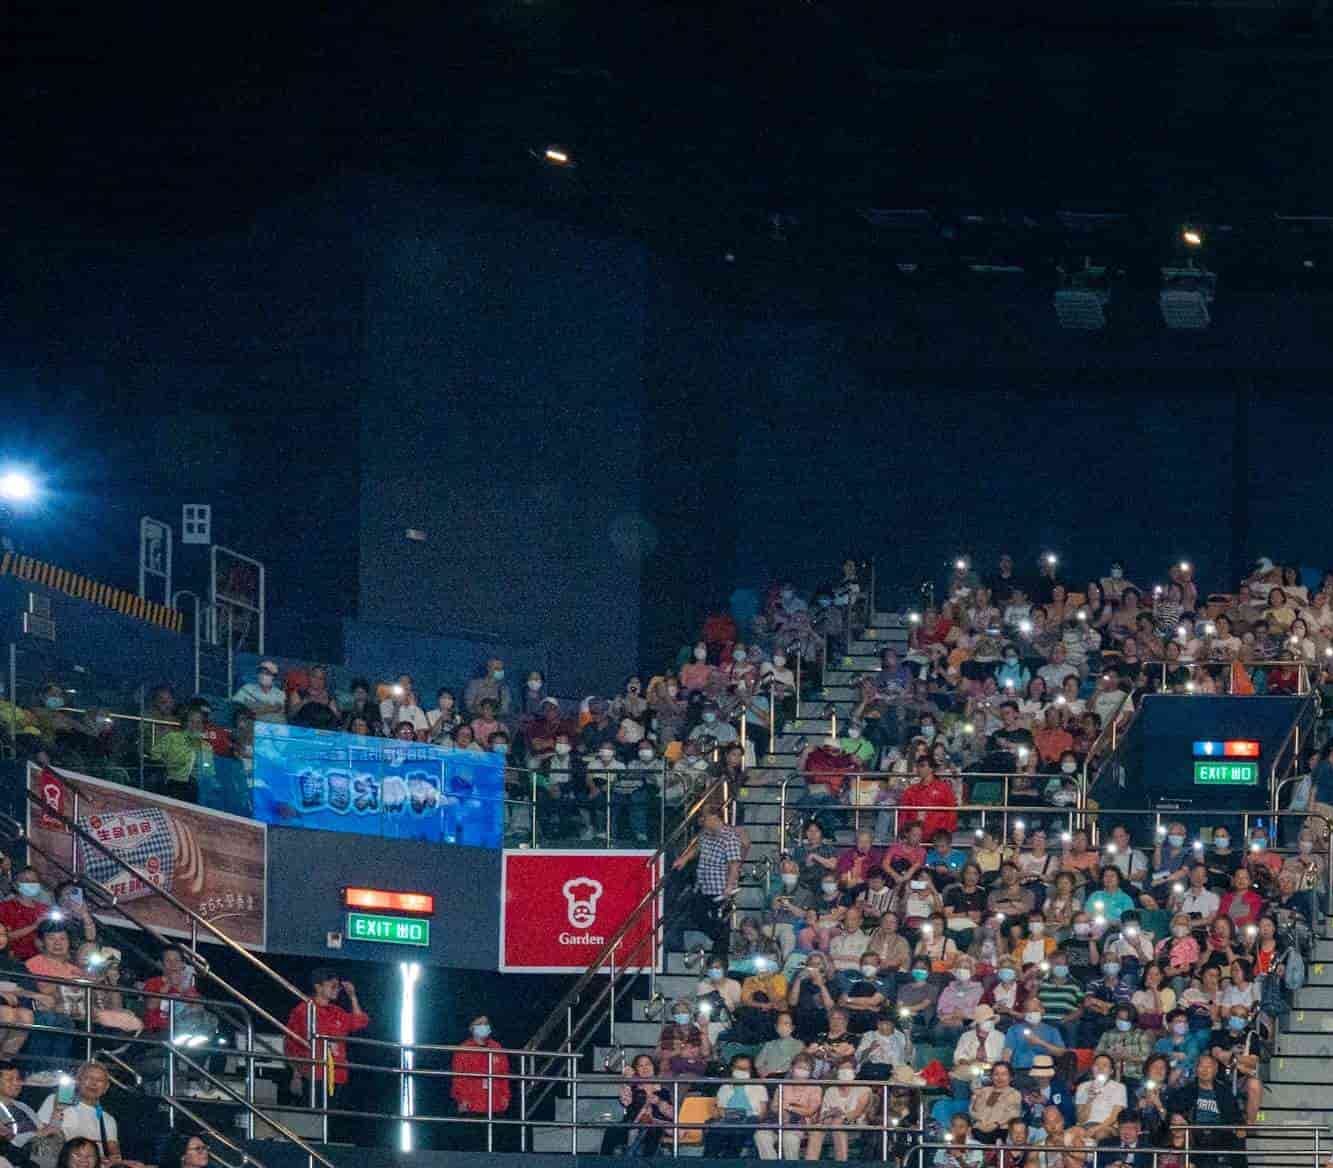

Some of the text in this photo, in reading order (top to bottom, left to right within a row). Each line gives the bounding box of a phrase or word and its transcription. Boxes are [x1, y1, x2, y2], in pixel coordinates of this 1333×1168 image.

[1200, 765, 1228, 780] EXIT
[356, 919, 394, 938] EXIT
[559, 932, 604, 946] Garden
